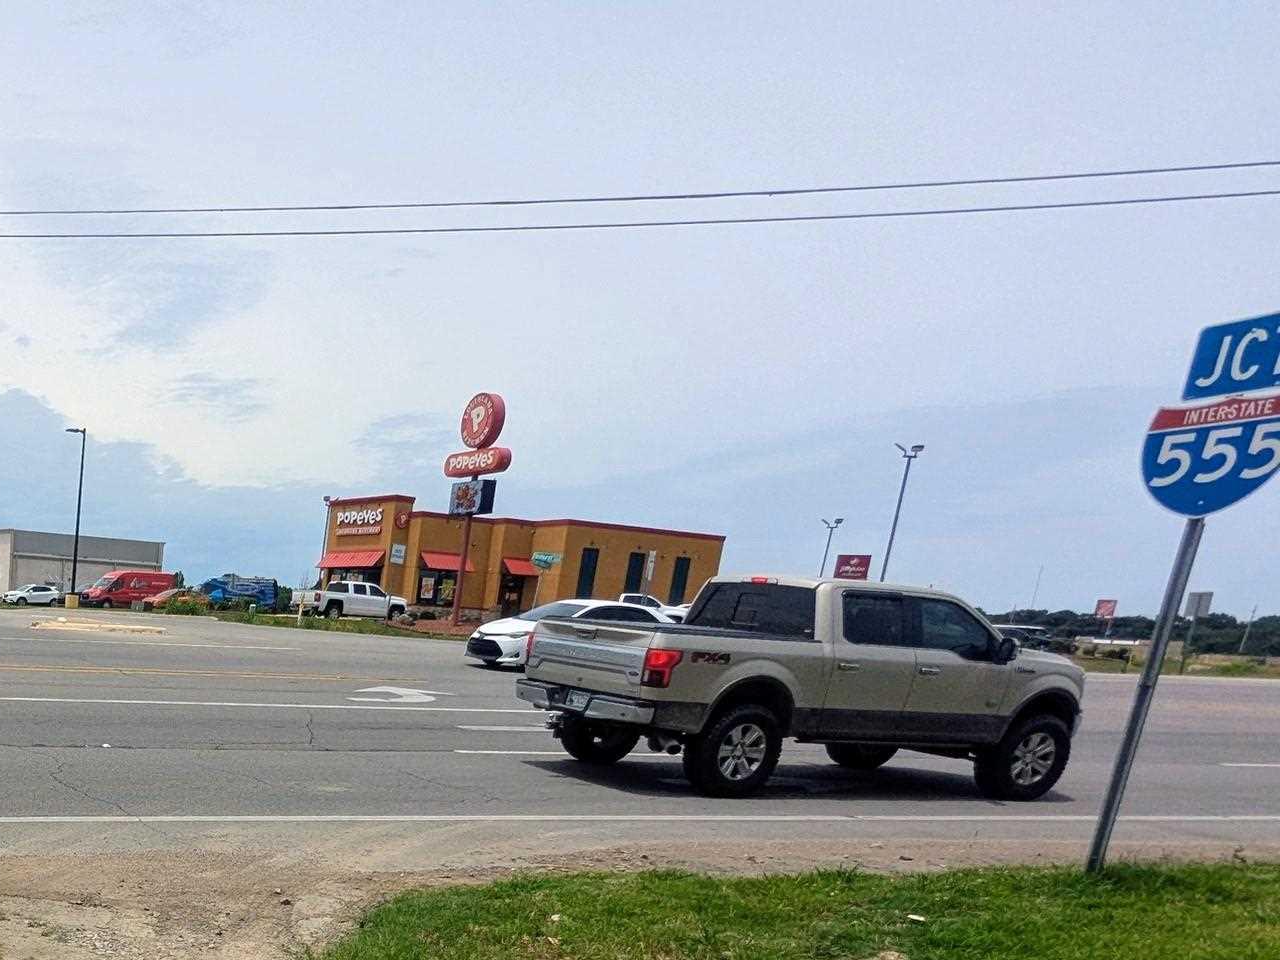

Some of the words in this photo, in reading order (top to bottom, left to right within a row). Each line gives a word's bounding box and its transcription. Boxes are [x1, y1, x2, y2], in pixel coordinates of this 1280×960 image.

[1196, 327, 1280, 388] JC
[1183, 398, 1275, 425] INTERSTATE
[1149, 423, 1280, 488] 555
[690, 651, 730, 664] FX4
